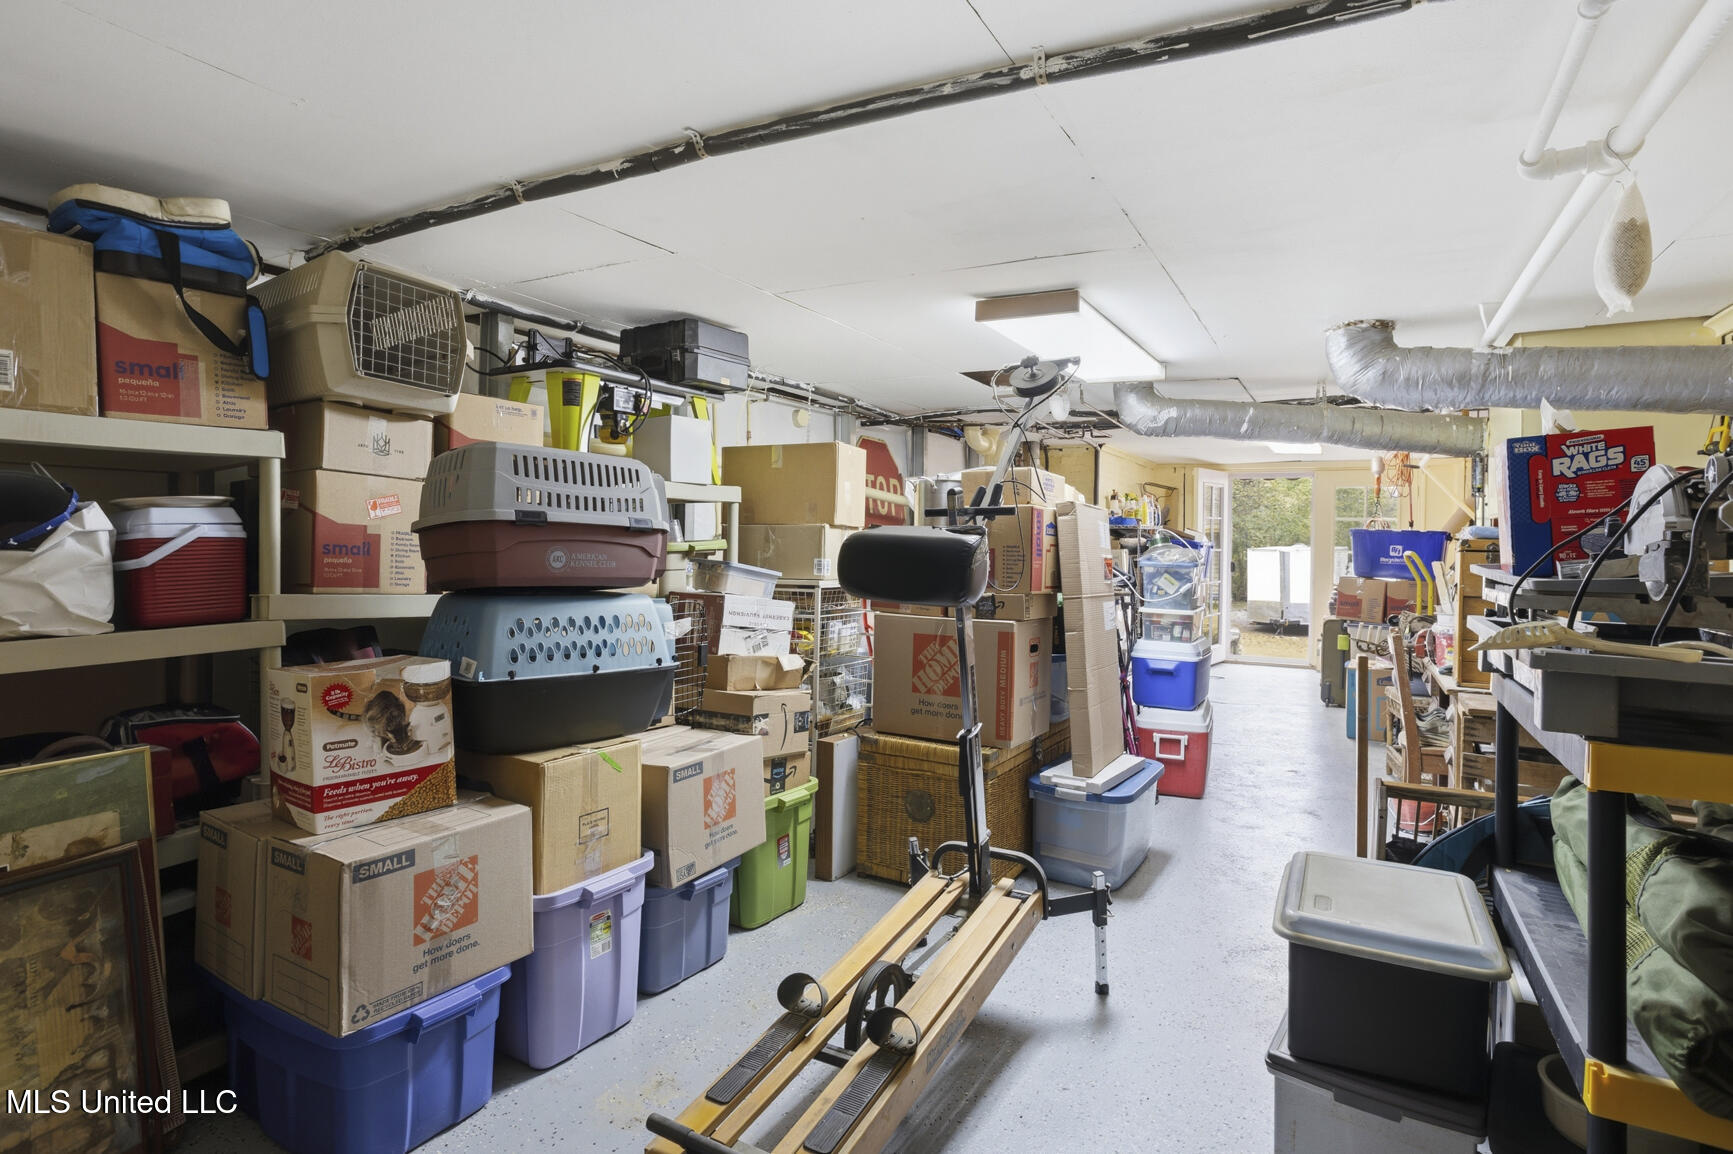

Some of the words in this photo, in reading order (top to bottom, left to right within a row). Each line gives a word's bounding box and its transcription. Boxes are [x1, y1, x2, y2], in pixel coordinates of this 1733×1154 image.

[114, 360, 184, 380] small
[118, 378, 160, 388] pequeña
[1514, 446, 1540, 454] BOX
[1561, 442, 1606, 457] WHITE
[1552, 446, 1625, 478] RAGS
[1633, 458, 1647, 467] 45
[866, 474, 901, 516] TOP
[322, 541, 371, 556] small
[918, 641, 940, 664] THE
[918, 698, 935, 707] How
[910, 707, 923, 716] get
[924, 709, 944, 717] more
[326, 741, 356, 750] Petmate
[675, 764, 701, 780] SMALL
[323, 786, 347, 797] Feeds
[348, 782, 371, 792] when
[371, 777, 396, 790] you're
[397, 773, 419, 782] away.
[323, 814, 335, 822] The
[336, 811, 351, 820] right
[324, 821, 341, 829] every
[201, 825, 226, 845] SMALL
[272, 851, 304, 871] SMALL
[359, 854, 411, 879] SMALL
[440, 880, 479, 933] DEPOT
[422, 946, 443, 958] How
[445, 933, 471, 949] doers
[412, 961, 428, 974] get
[430, 950, 454, 966] more
[456, 940, 481, 955] done.
